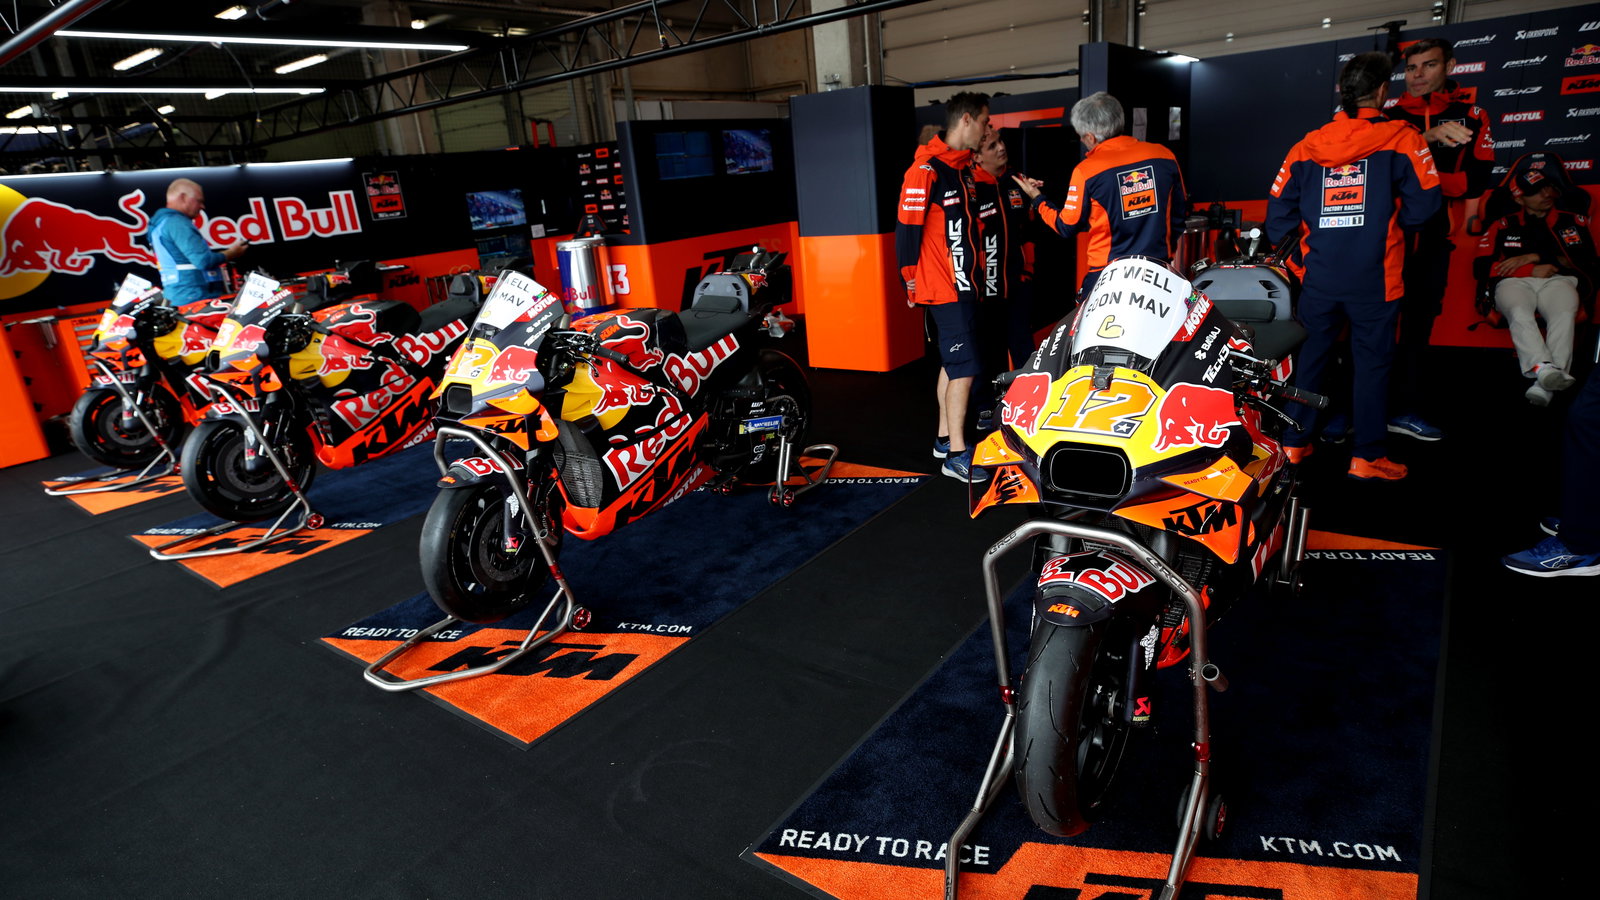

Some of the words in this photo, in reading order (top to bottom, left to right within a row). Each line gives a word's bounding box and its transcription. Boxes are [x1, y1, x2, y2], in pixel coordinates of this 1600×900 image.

[1502, 112, 1542, 123] MOTUL
[1121, 183, 1137, 195] Red
[1137, 179, 1153, 192] Bull
[1325, 177, 1345, 188] Red
[1345, 174, 1364, 186] Bull
[1128, 195, 1150, 207] KTM
[1330, 191, 1358, 201] KTM
[273, 190, 362, 241] Bull
[1320, 217, 1350, 227] Mobil
[506, 277, 530, 293] ELL
[1094, 268, 1118, 292] GET
[1123, 266, 1172, 294] WELL
[500, 292, 525, 307] MAV
[527, 294, 557, 319] MOTUL
[1086, 291, 1122, 317] SOON
[1129, 292, 1171, 319] MAV
[1184, 296, 1210, 336] MOTUL
[391, 318, 468, 368] Bull
[663, 333, 740, 399] Bull
[1202, 344, 1230, 384] TECH3
[330, 356, 417, 432] Red
[1040, 375, 1158, 439] 12
[403, 422, 435, 449] MOTU
[602, 386, 693, 492] Red
[1220, 465, 1235, 474] RACE
[1161, 498, 1237, 536] KTM
[1340, 552, 1367, 560] TO
[1371, 552, 1436, 560] READY
[1074, 550, 1156, 604] Bull
[1048, 603, 1080, 618] KTM
[342, 627, 398, 637] READY
[396, 628, 418, 638] TO
[617, 622, 693, 634] KTM.COM
[426, 640, 640, 681] KTM
[779, 828, 870, 852] READY
[876, 836, 909, 857] TO
[1260, 836, 1402, 862] KTM.COM
